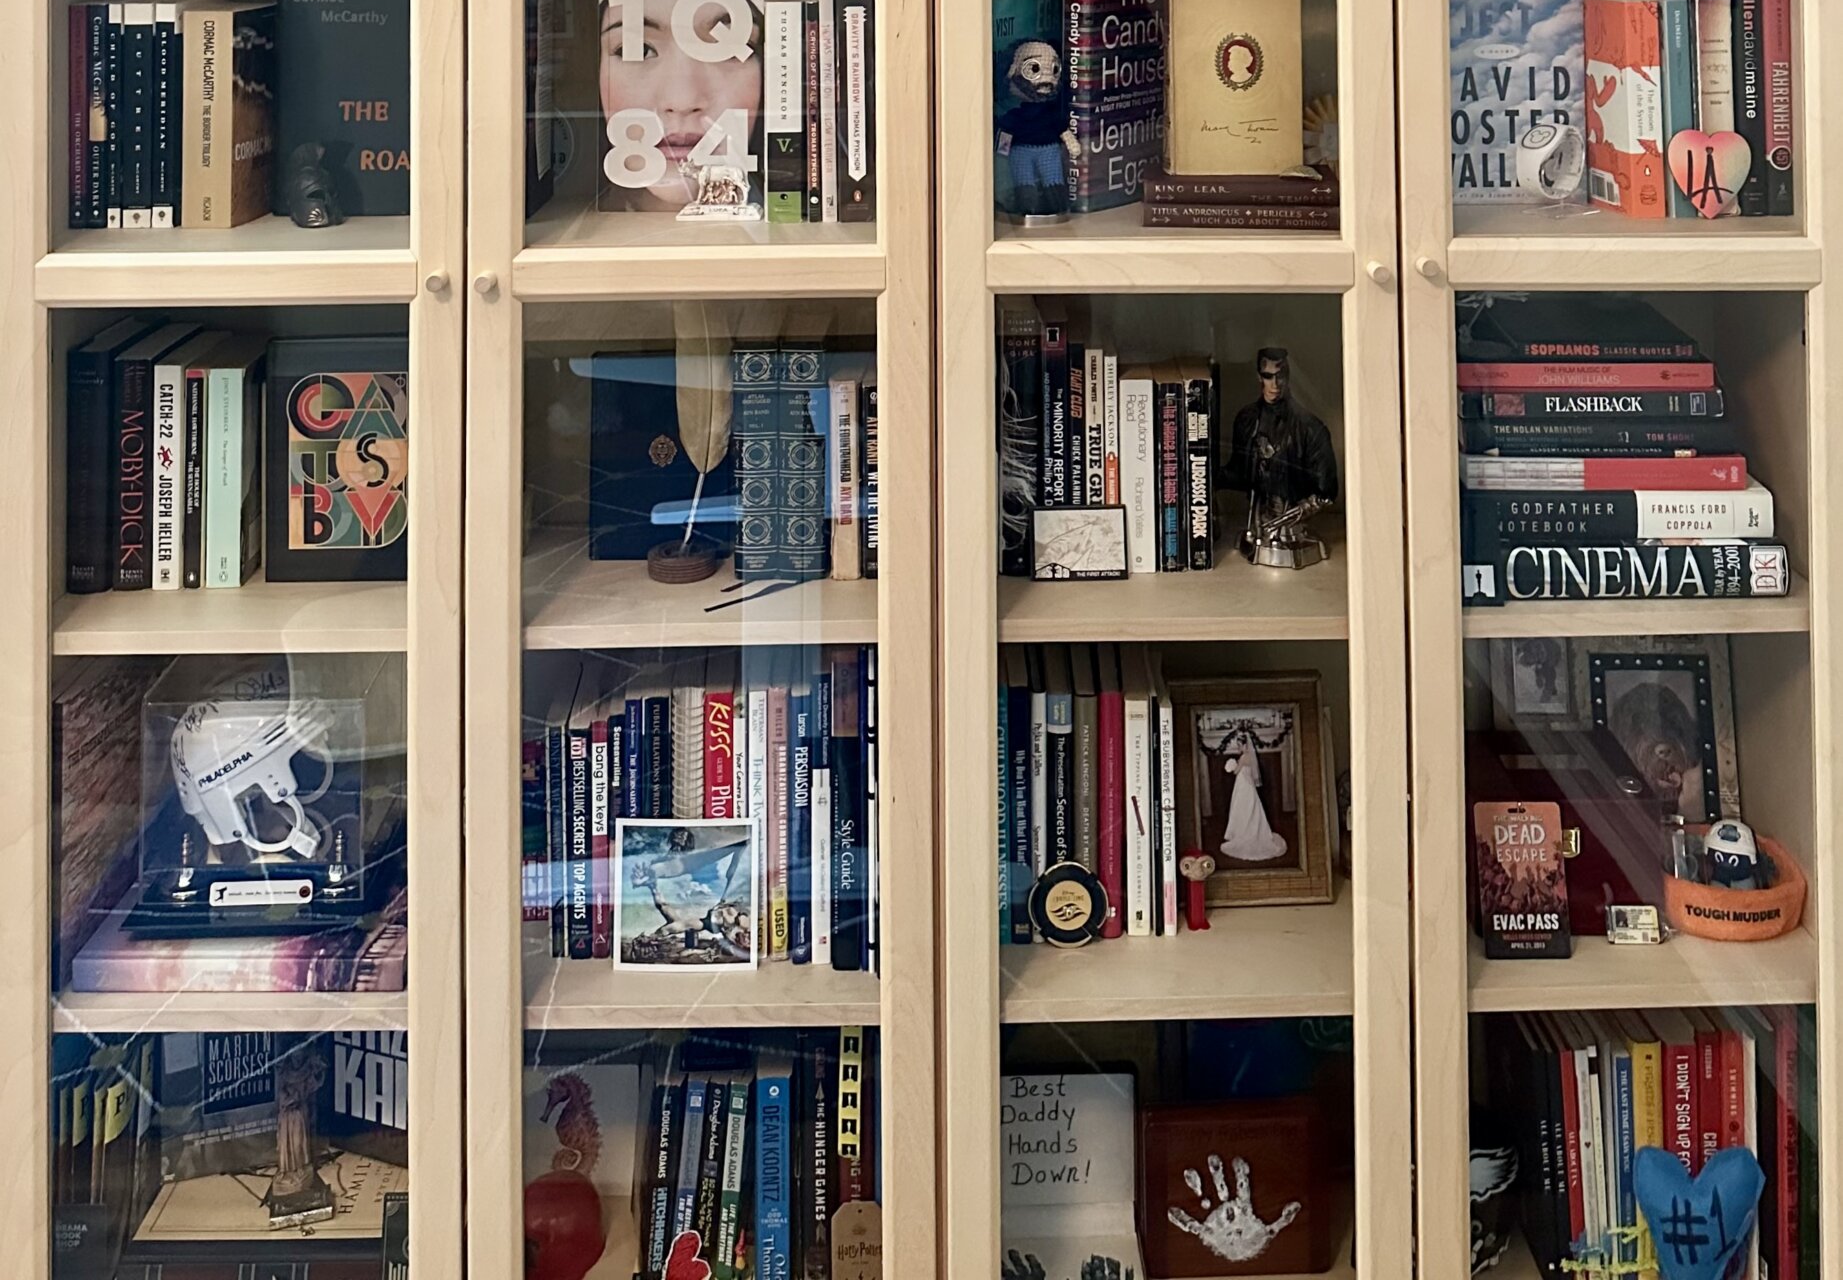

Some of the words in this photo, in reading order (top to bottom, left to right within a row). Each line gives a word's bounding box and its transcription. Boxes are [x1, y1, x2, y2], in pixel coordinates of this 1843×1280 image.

[203, 20, 214, 55] CORMAC
[1070, 2, 1080, 44] Candy
[203, 56, 214, 101] McCARTHY
[1070, 43, 1079, 89] House
[1101, 55, 1164, 90] House
[339, 101, 388, 122] THE
[1772, 62, 1789, 143] FAHRENHEIT
[360, 150, 410, 170] ROA
[603, 108, 758, 189] 84
[776, 137, 794, 153] V.
[1155, 185, 1184, 193] KING
[1194, 185, 1230, 194] LEAR
[1182, 208, 1239, 217] ANDRONICUS
[1257, 210, 1302, 218] PERICLES
[1530, 344, 1599, 356] SOPRANOS
[159, 383, 173, 439] CATCH-22
[1127, 395, 1136, 422] Road
[1545, 397, 1643, 412] FLASHBACK
[1054, 402, 1064, 456] MINORITY
[1136, 395, 1148, 463] Revolutionary
[1089, 424, 1102, 469] TRUE
[120, 409, 144, 565] MOBY-DICK
[1054, 460, 1065, 504] REPORT
[1191, 454, 1208, 504] JURASSIC
[159, 475, 173, 517] JOSEPH
[1511, 503, 1614, 515] GODFATHER
[1652, 504, 1695, 514] FRANCIS
[1701, 504, 1726, 514] FORD
[1191, 506, 1208, 538] PARK
[1667, 521, 1712, 530] COPPOLA
[159, 521, 172, 562] HELLER
[1507, 546, 1706, 599] CINEMA
[198, 751, 253, 787] PHILADELPHIA
[593, 745, 606, 778] bang
[795, 747, 809, 807] PERSUASION
[1057, 753, 1066, 798] Presentation
[573, 760, 585, 814] BESTSELLING
[596, 781, 606, 801] the
[593, 804, 605, 833] keys
[1056, 799, 1067, 836] Secrets
[573, 816, 585, 855] SECRETS
[836, 820, 853, 849] Style
[1057, 837, 1067, 850] of
[1494, 825, 1545, 845] DEAD
[574, 862, 585, 880] TOP
[841, 852, 853, 890] Guide
[1497, 849, 1547, 862] ESCAPE
[574, 883, 586, 920] AGENTS
[1685, 904, 1730, 921] TOUGH
[1733, 908, 1781, 921] MUDDER
[775, 909, 784, 938] USED
[1493, 914, 1524, 930] EVAC
[1527, 914, 1559, 930] PASS
[209, 1032, 271, 1060] MARTIN
[209, 1052, 271, 1084] SCORSESE
[1676, 1064, 1690, 1101] DIDN'T
[1011, 1074, 1066, 1097] Best
[662, 1110, 670, 1147] DOUGLAS
[763, 1105, 779, 1142] DEAN
[1001, 1100, 1074, 1131] Daddy
[1676, 1103, 1691, 1131] SIGN
[815, 1121, 825, 1175] HUNGER
[1009, 1130, 1077, 1155] Hands
[1677, 1132, 1691, 1150] UP
[658, 1152, 667, 1178] ADAMS
[762, 1147, 779, 1203] KOONTZ
[1012, 1160, 1090, 1185] Down!
[815, 1178, 825, 1220] GAMES
